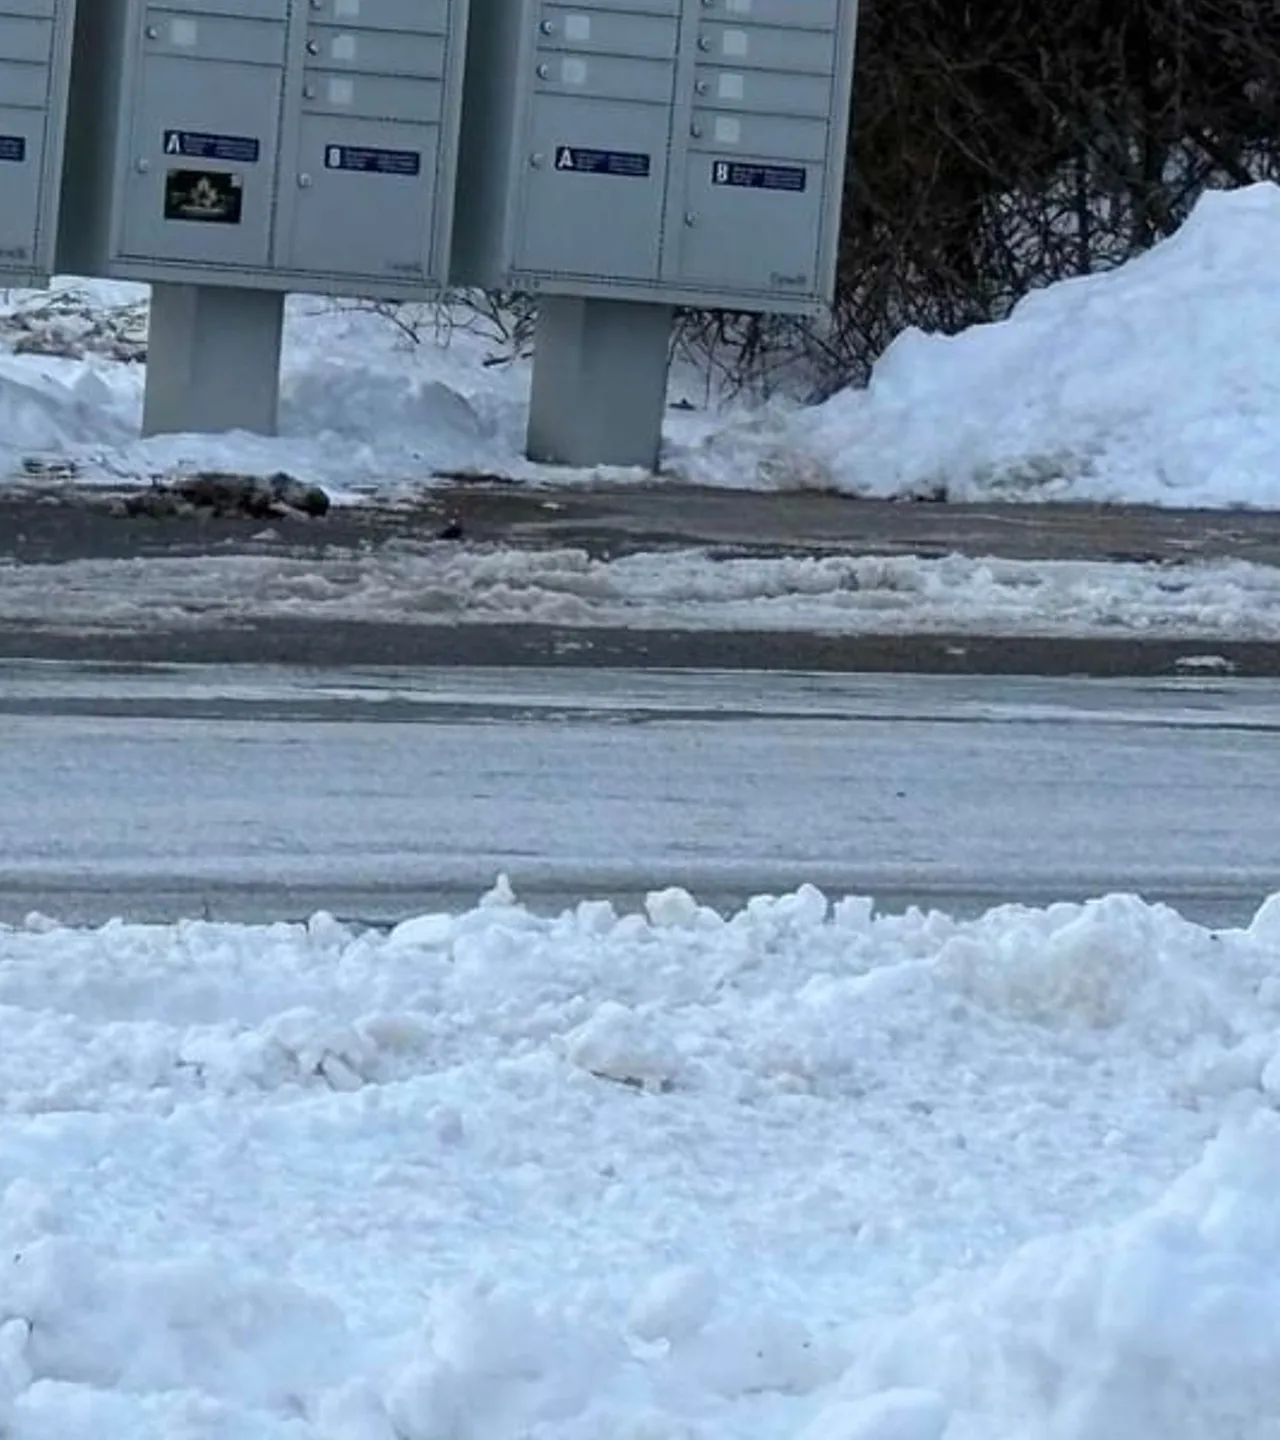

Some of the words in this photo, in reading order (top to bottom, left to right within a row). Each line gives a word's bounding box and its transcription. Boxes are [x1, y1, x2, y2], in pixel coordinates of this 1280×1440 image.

[166, 133, 182, 153] A
[557, 148, 574, 169] A
[716, 163, 729, 183] B
